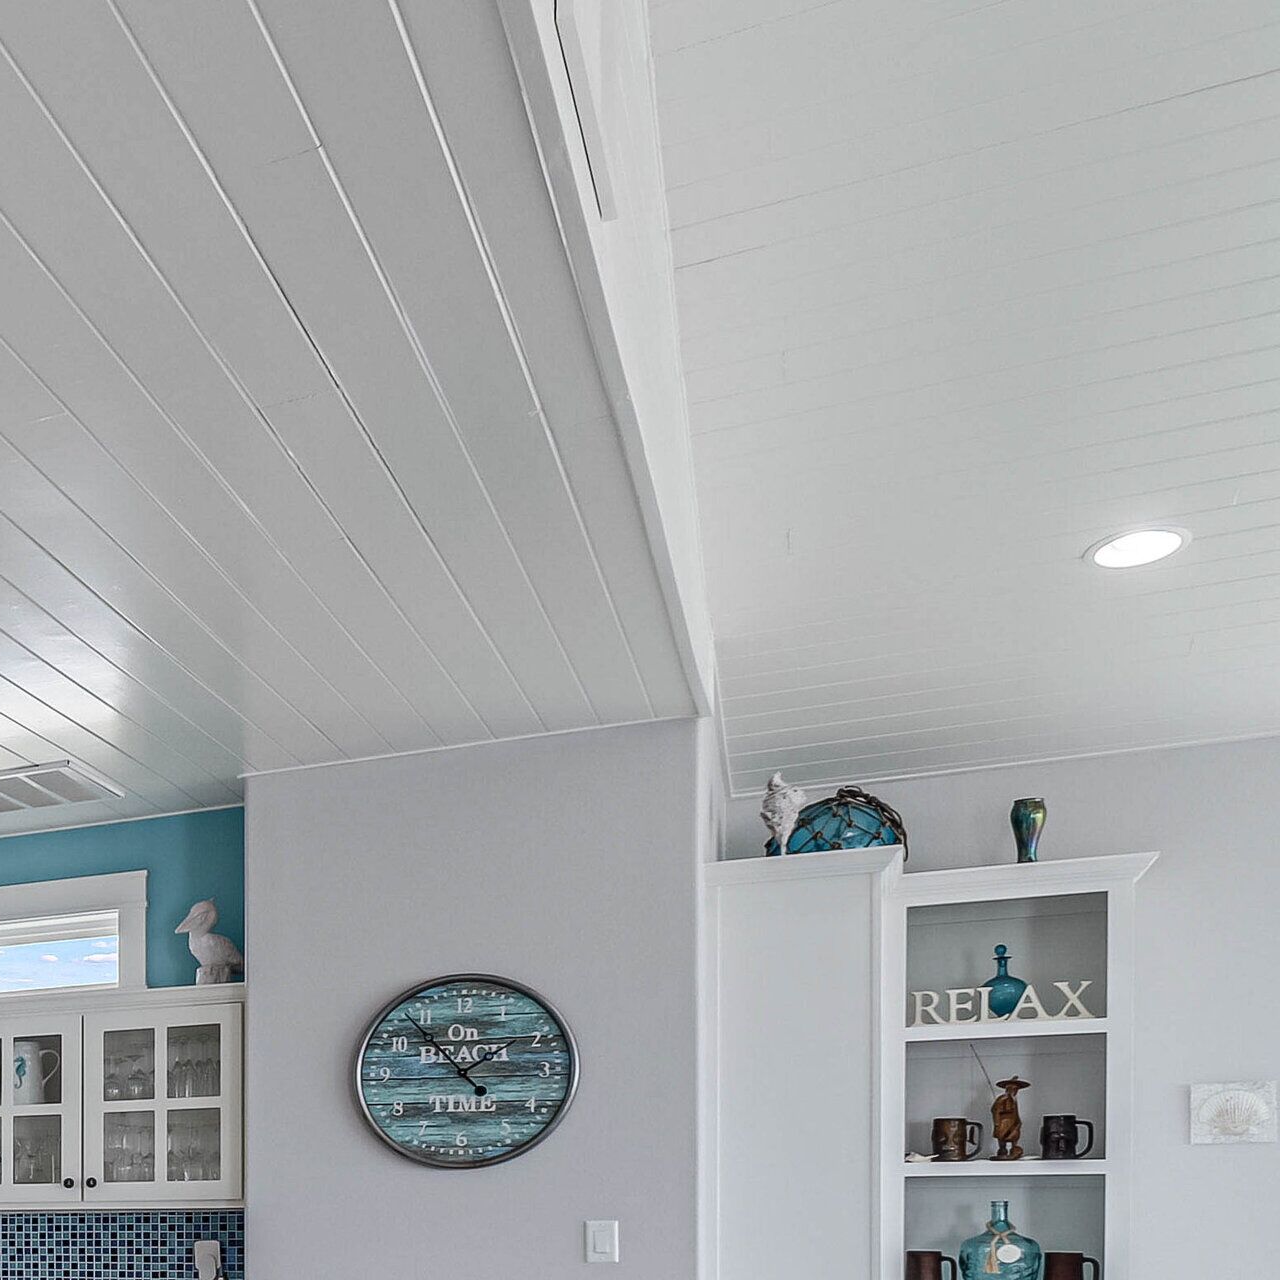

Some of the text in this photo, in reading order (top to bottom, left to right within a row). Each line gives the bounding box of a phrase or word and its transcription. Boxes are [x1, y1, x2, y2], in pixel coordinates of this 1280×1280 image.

[457, 998, 473, 1014] 12
[910, 980, 1096, 1026] RELAX
[419, 1009, 432, 1024] 11
[499, 1006, 507, 1021] 1
[447, 1023, 479, 1041] On
[531, 1031, 541, 1047] 2
[391, 1036, 408, 1052] 10
[419, 1044, 509, 1064] BEACH
[380, 1067, 390, 1082] 9
[538, 1062, 550, 1078] 3
[393, 1101, 403, 1116] 8
[428, 1094, 497, 1113] TIME
[525, 1097, 536, 1113] 4
[418, 1121, 429, 1136] 7
[501, 1119, 511, 1135] 5
[456, 1130, 467, 1146] 6
